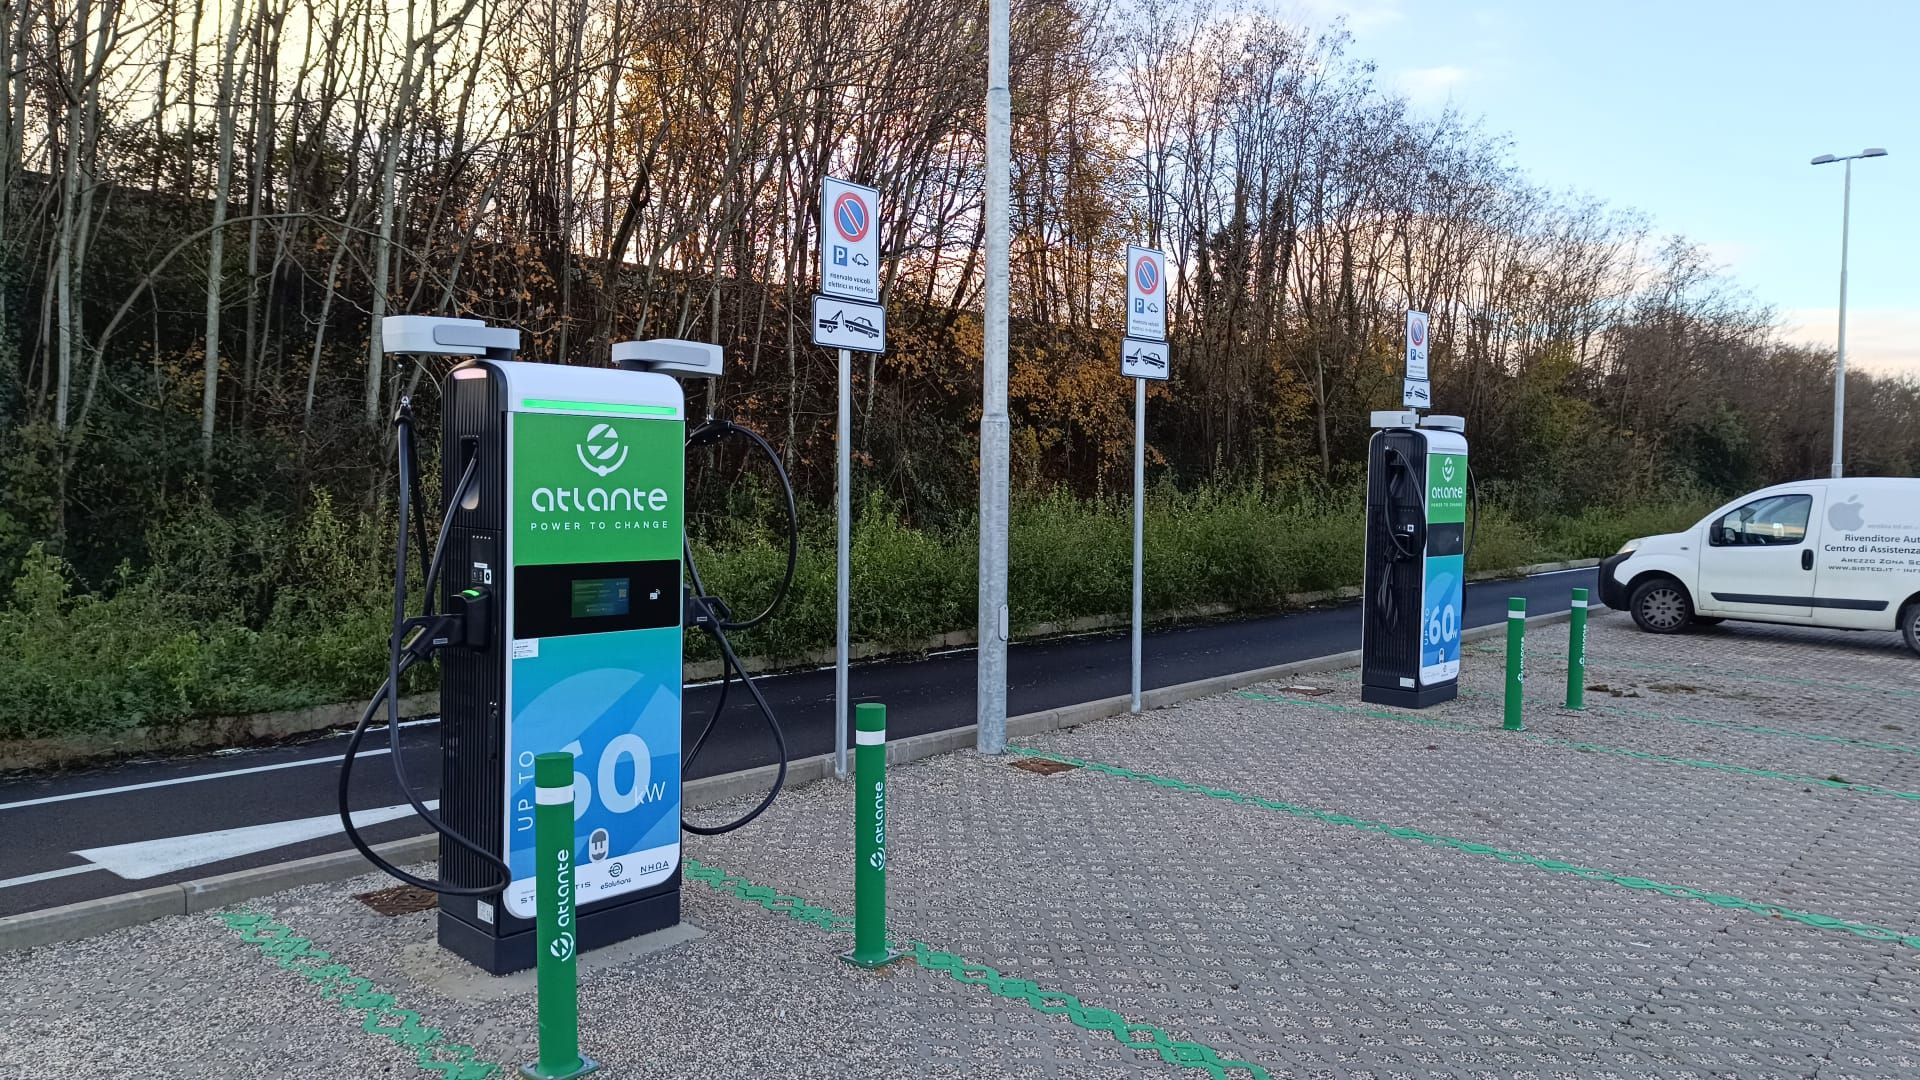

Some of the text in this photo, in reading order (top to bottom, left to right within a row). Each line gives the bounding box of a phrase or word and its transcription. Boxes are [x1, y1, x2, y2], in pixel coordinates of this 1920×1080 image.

[836, 248, 845, 263] P
[531, 487, 668, 512] atlante
[1431, 486, 1463, 499] atlante
[531, 520, 668, 531] POWER TO CHANGE
[1844, 533, 1901, 543] Rivenditore
[1824, 544, 1856, 552] Centro
[1870, 545, 1920, 554] Assistenza
[1429, 604, 1455, 645] 60
[518, 751, 535, 831] UP TO
[634, 781, 666, 806] kW
[875, 781, 884, 844] atlante
[557, 849, 570, 927] atlante
[600, 877, 632, 890] eSolutions
